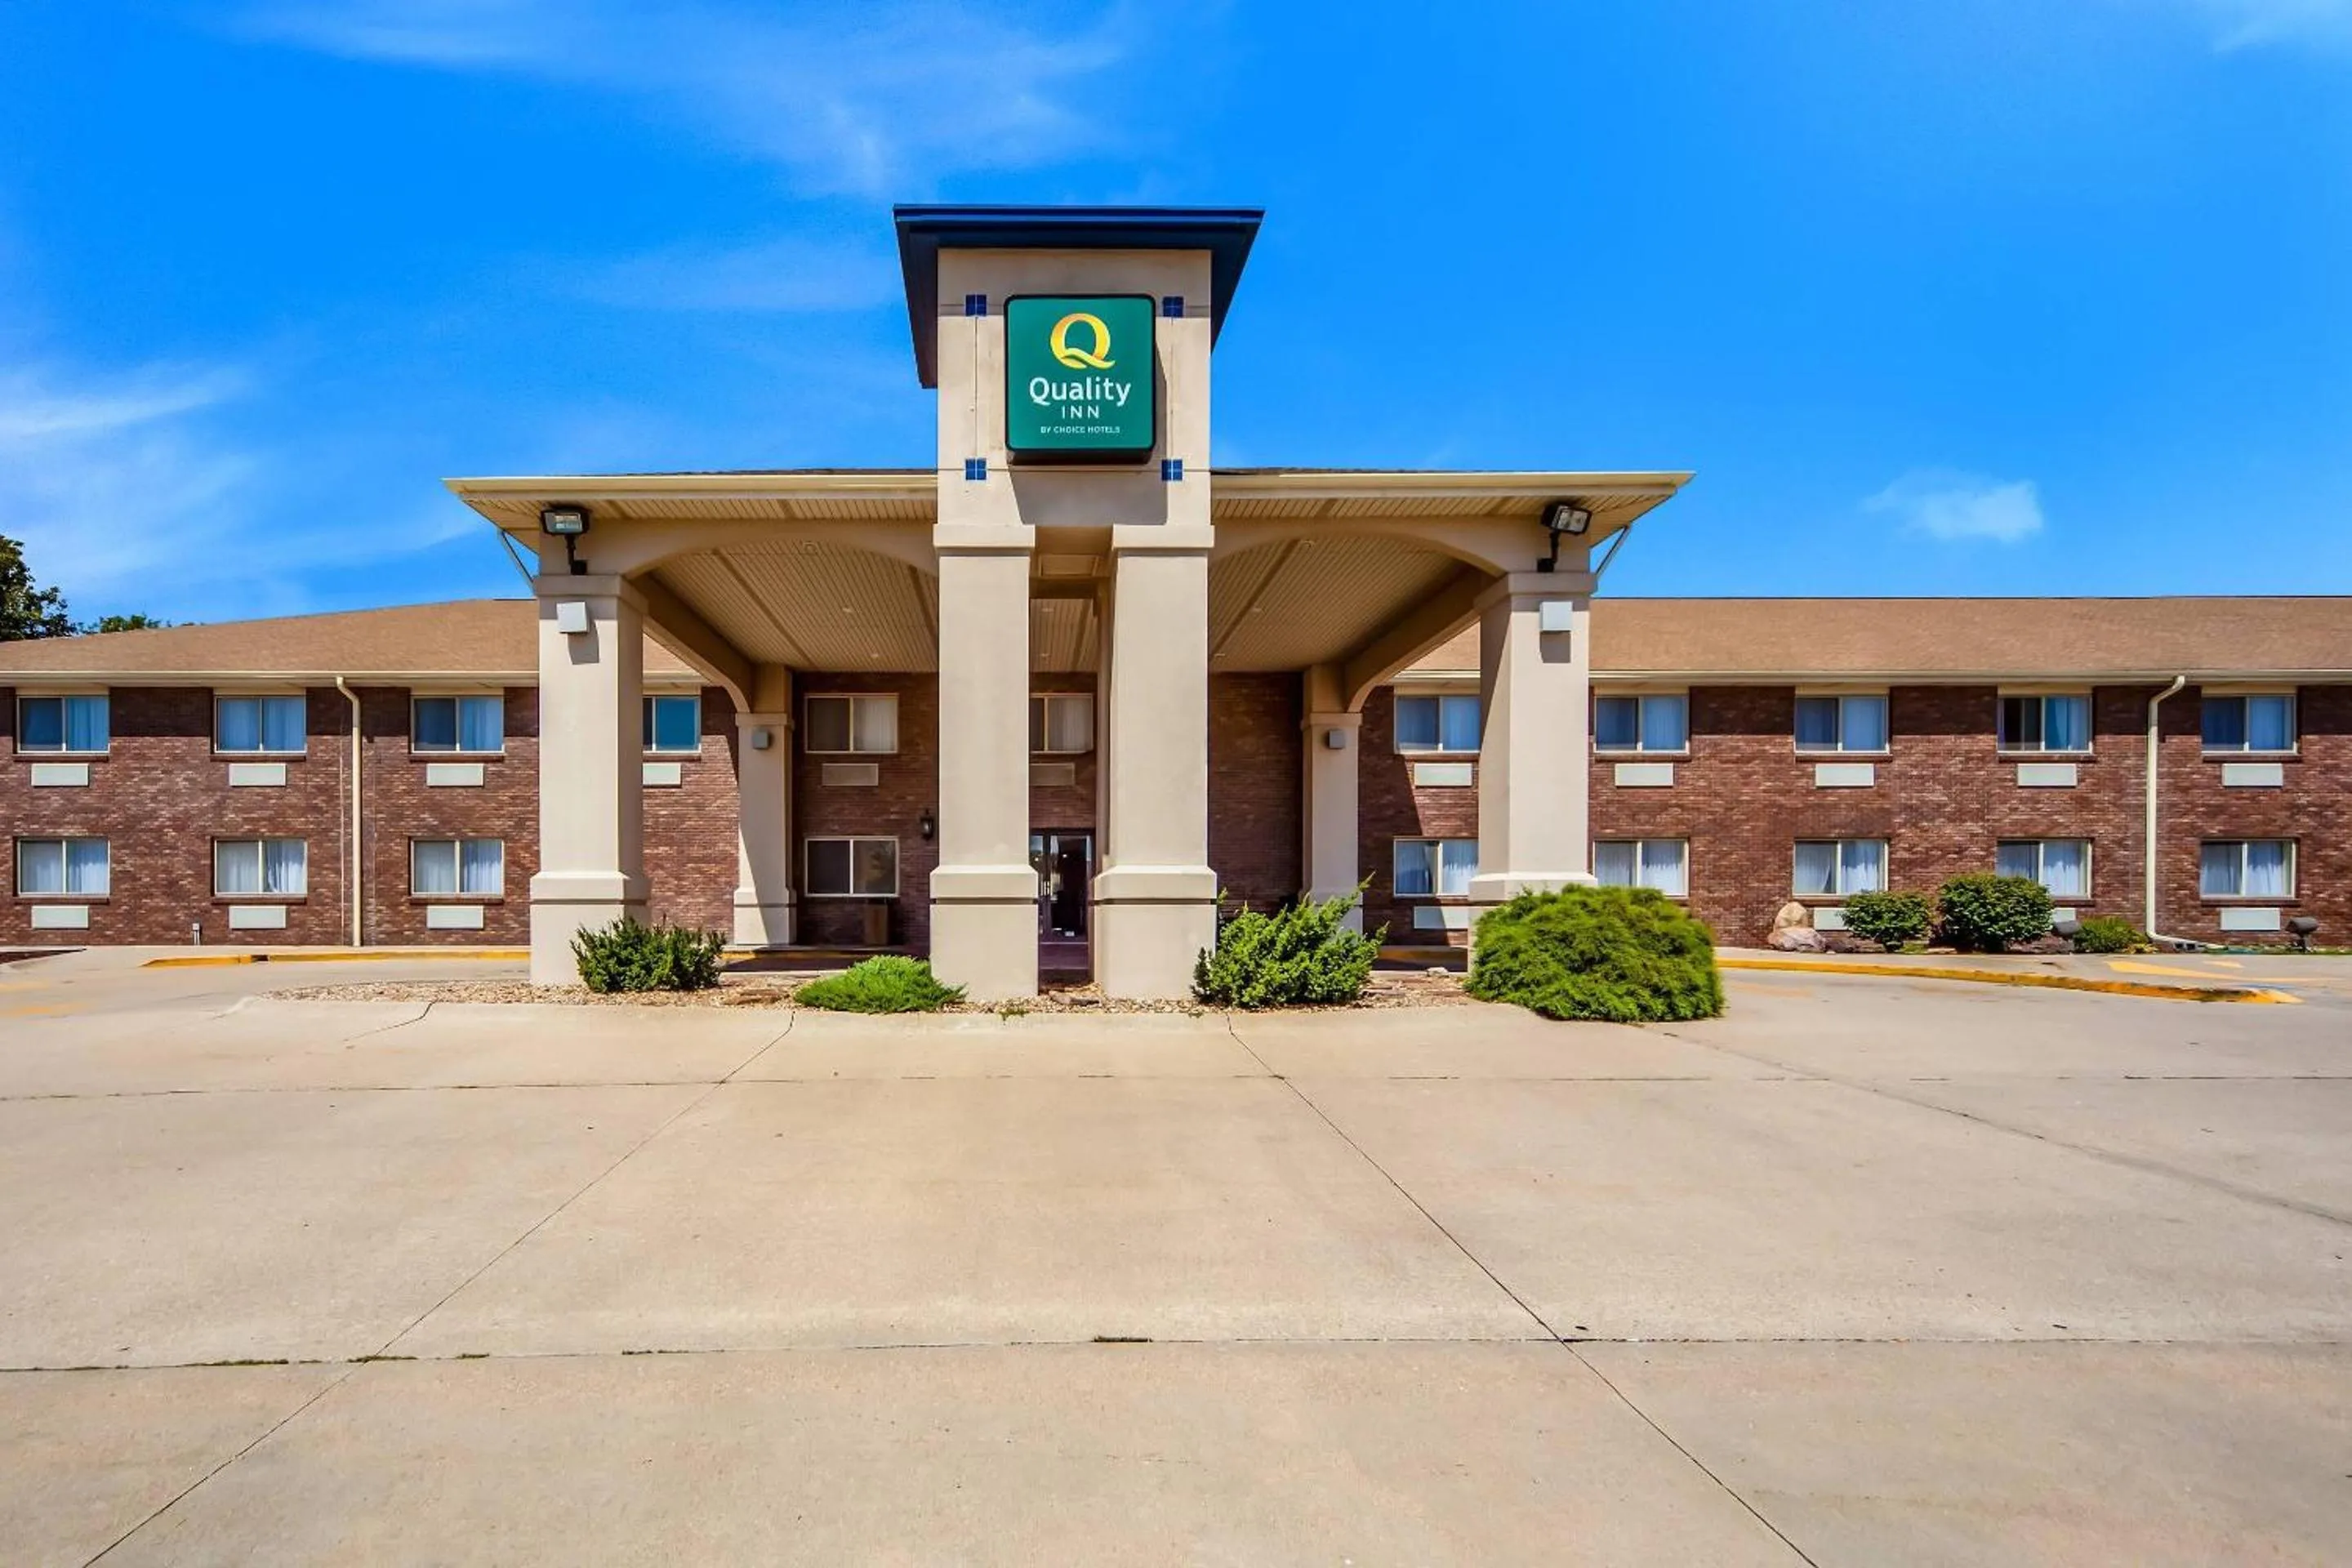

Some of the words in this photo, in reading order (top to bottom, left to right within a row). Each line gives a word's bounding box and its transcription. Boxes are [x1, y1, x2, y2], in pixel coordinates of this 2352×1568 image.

[1029, 376, 1131, 407] Quality
[1062, 405, 1100, 419] INN
[1040, 425, 1051, 434] BY
[1054, 425, 1085, 434] CHOICE
[1088, 425, 1120, 434] HOTELS
